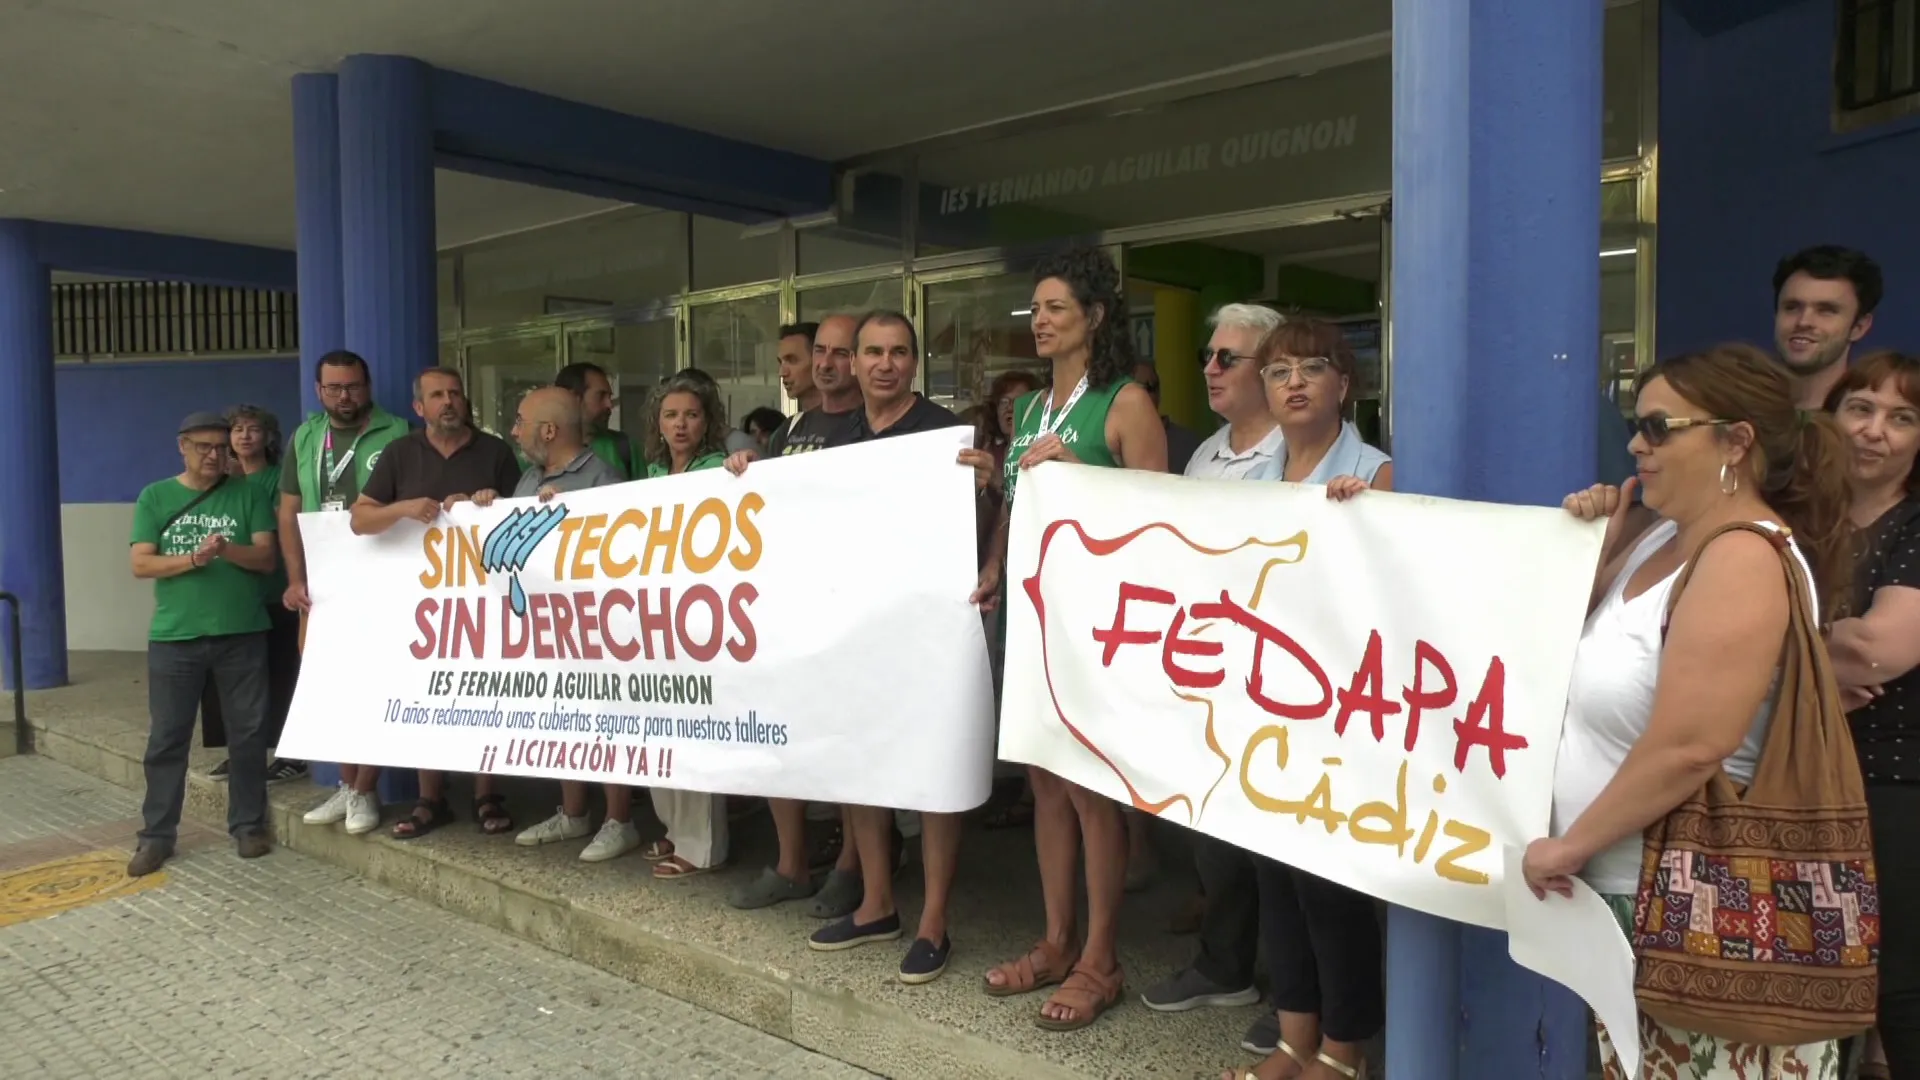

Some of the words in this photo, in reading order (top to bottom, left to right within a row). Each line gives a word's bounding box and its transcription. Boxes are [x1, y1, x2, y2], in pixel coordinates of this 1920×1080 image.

[940, 187, 970, 216] IES
[975, 164, 1095, 209] FERNANDO
[1101, 142, 1211, 187] AGUILAR
[1220, 114, 1358, 168] QUIGNON
[419, 525, 486, 589] SIN
[554, 492, 765, 581] TECHOS
[409, 597, 486, 660] SIN
[501, 582, 759, 662] DERECHOS
[428, 671, 454, 696] IES
[457, 671, 548, 698] FERNANDO
[553, 672, 622, 701] AGUILAR
[628, 673, 713, 705] QUIGNON
[1092, 581, 1528, 779] FEDAPA
[384, 698, 401, 723] 10
[402, 701, 430, 724] años
[432, 699, 503, 728] reclamando
[506, 709, 536, 730] unas
[539, 701, 592, 732] cubiertas
[595, 712, 640, 741] seguras
[643, 716, 673, 742] para
[677, 715, 732, 742] nuestros
[735, 710, 788, 746] talleres
[505, 736, 617, 772] LICITACIÓN
[626, 745, 649, 776] YA
